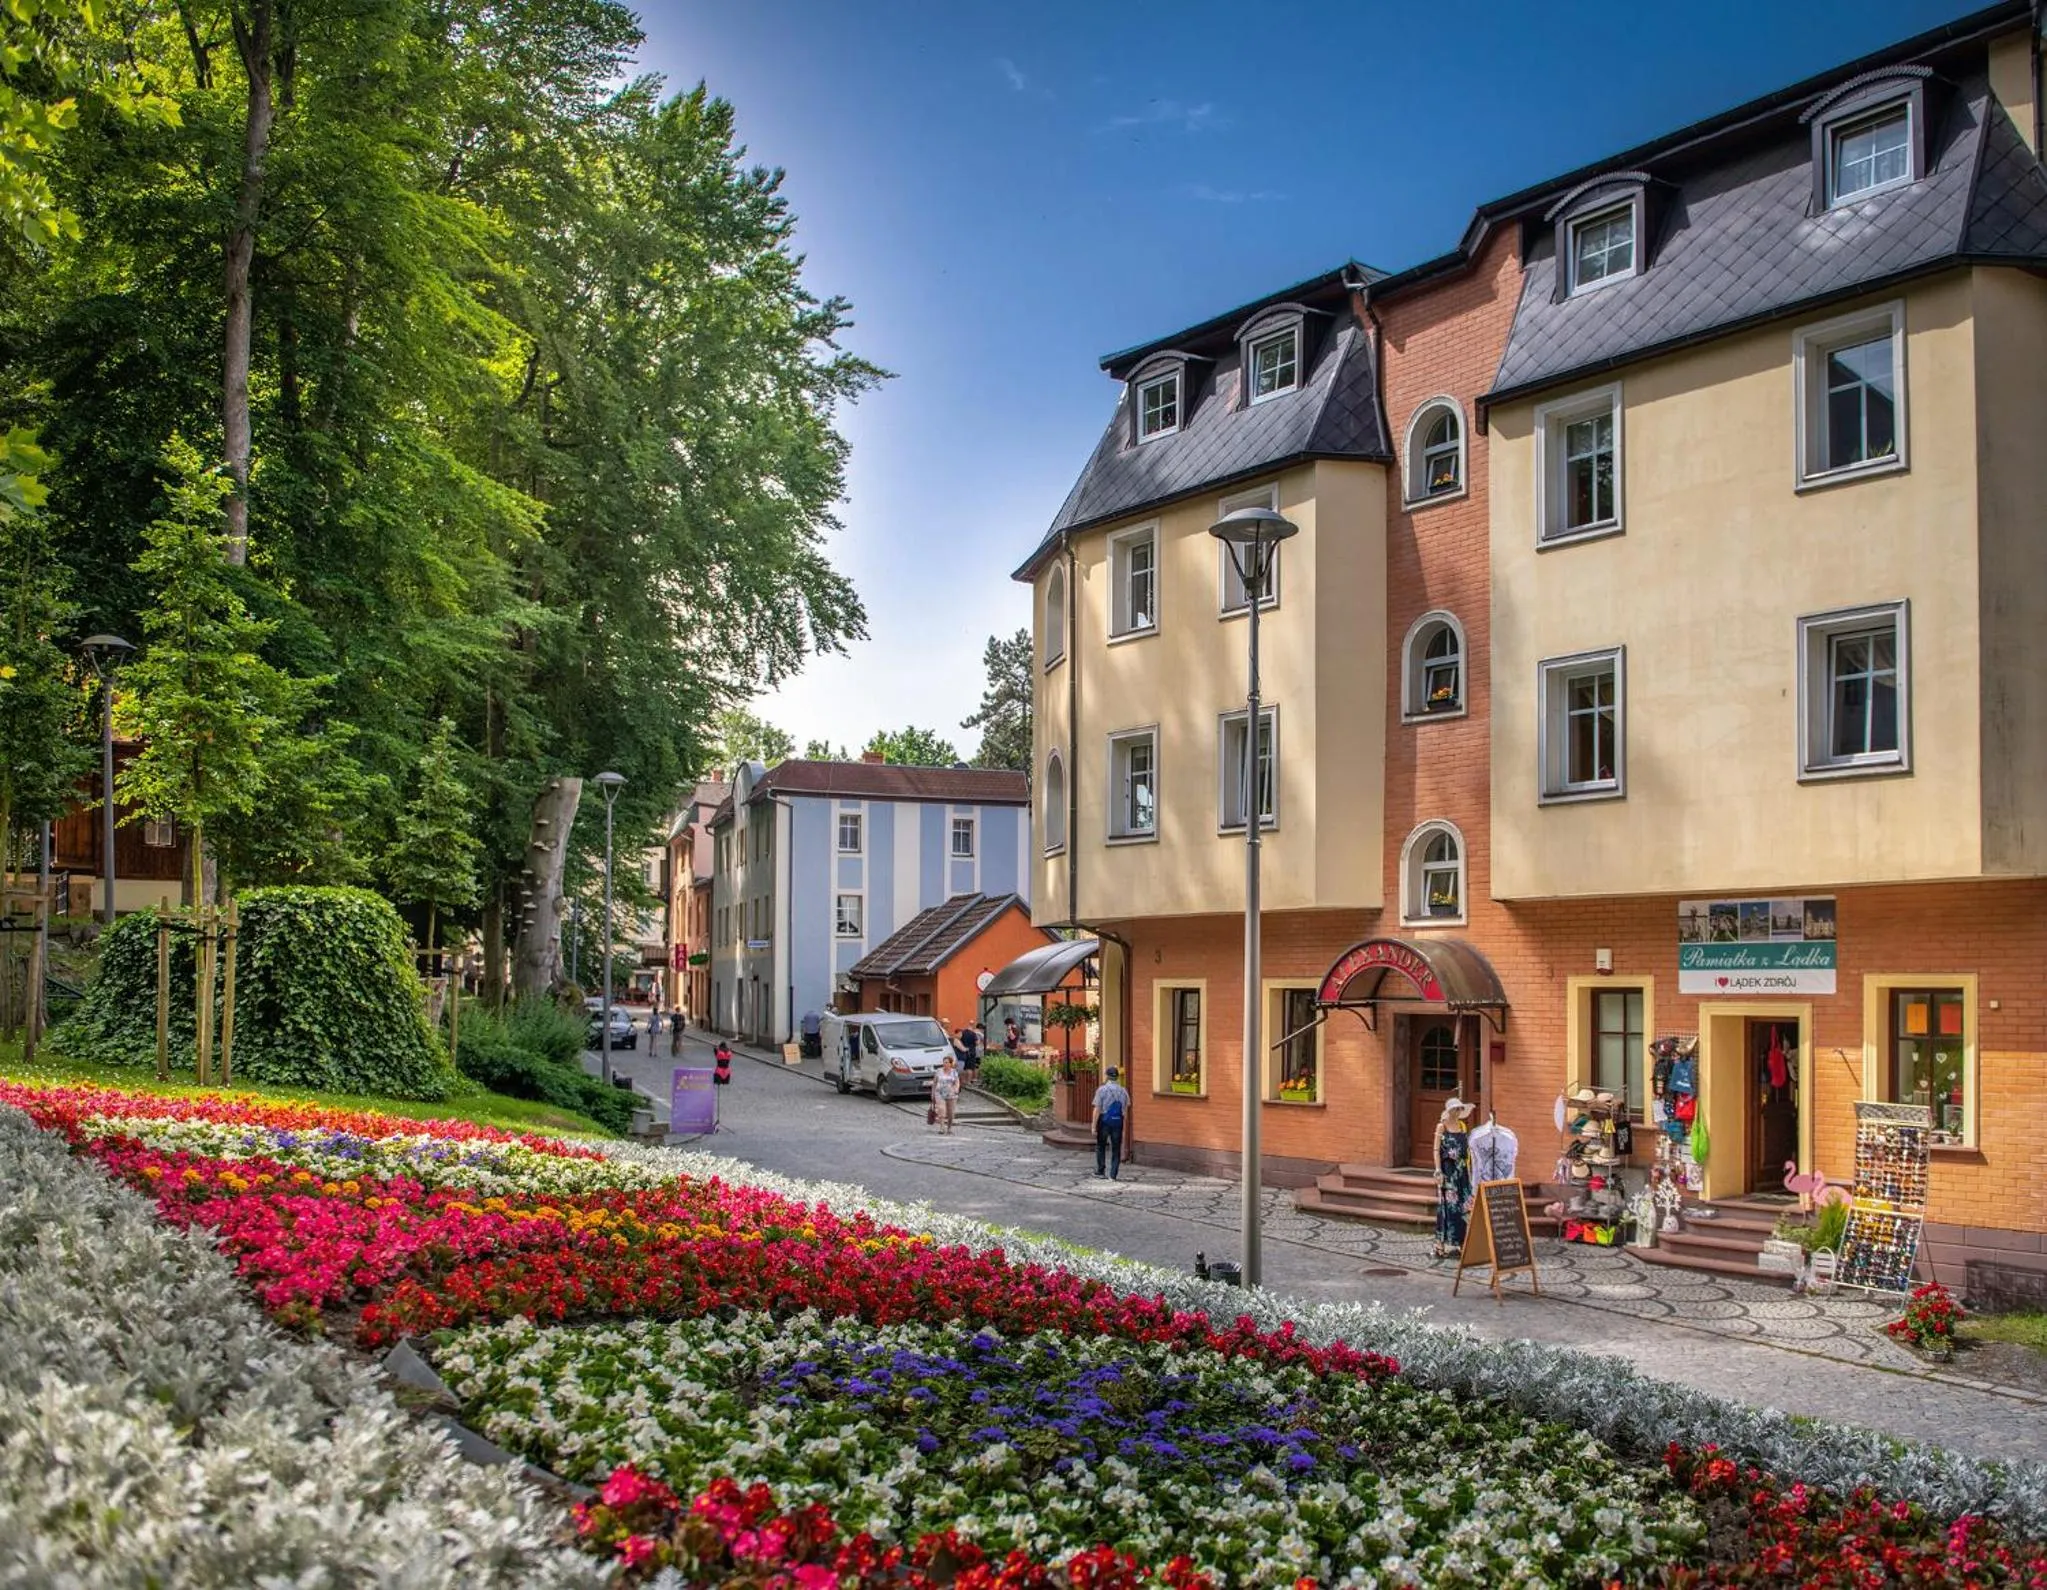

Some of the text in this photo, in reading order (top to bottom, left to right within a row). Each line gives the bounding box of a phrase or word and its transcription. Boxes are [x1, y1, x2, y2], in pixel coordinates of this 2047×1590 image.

[1331, 943, 1435, 993] ALEXANDER
[1775, 944, 1831, 969] Lądka
[1729, 977, 1762, 990] LĄDEK
[1763, 975, 1797, 988] ZDRÓJ
